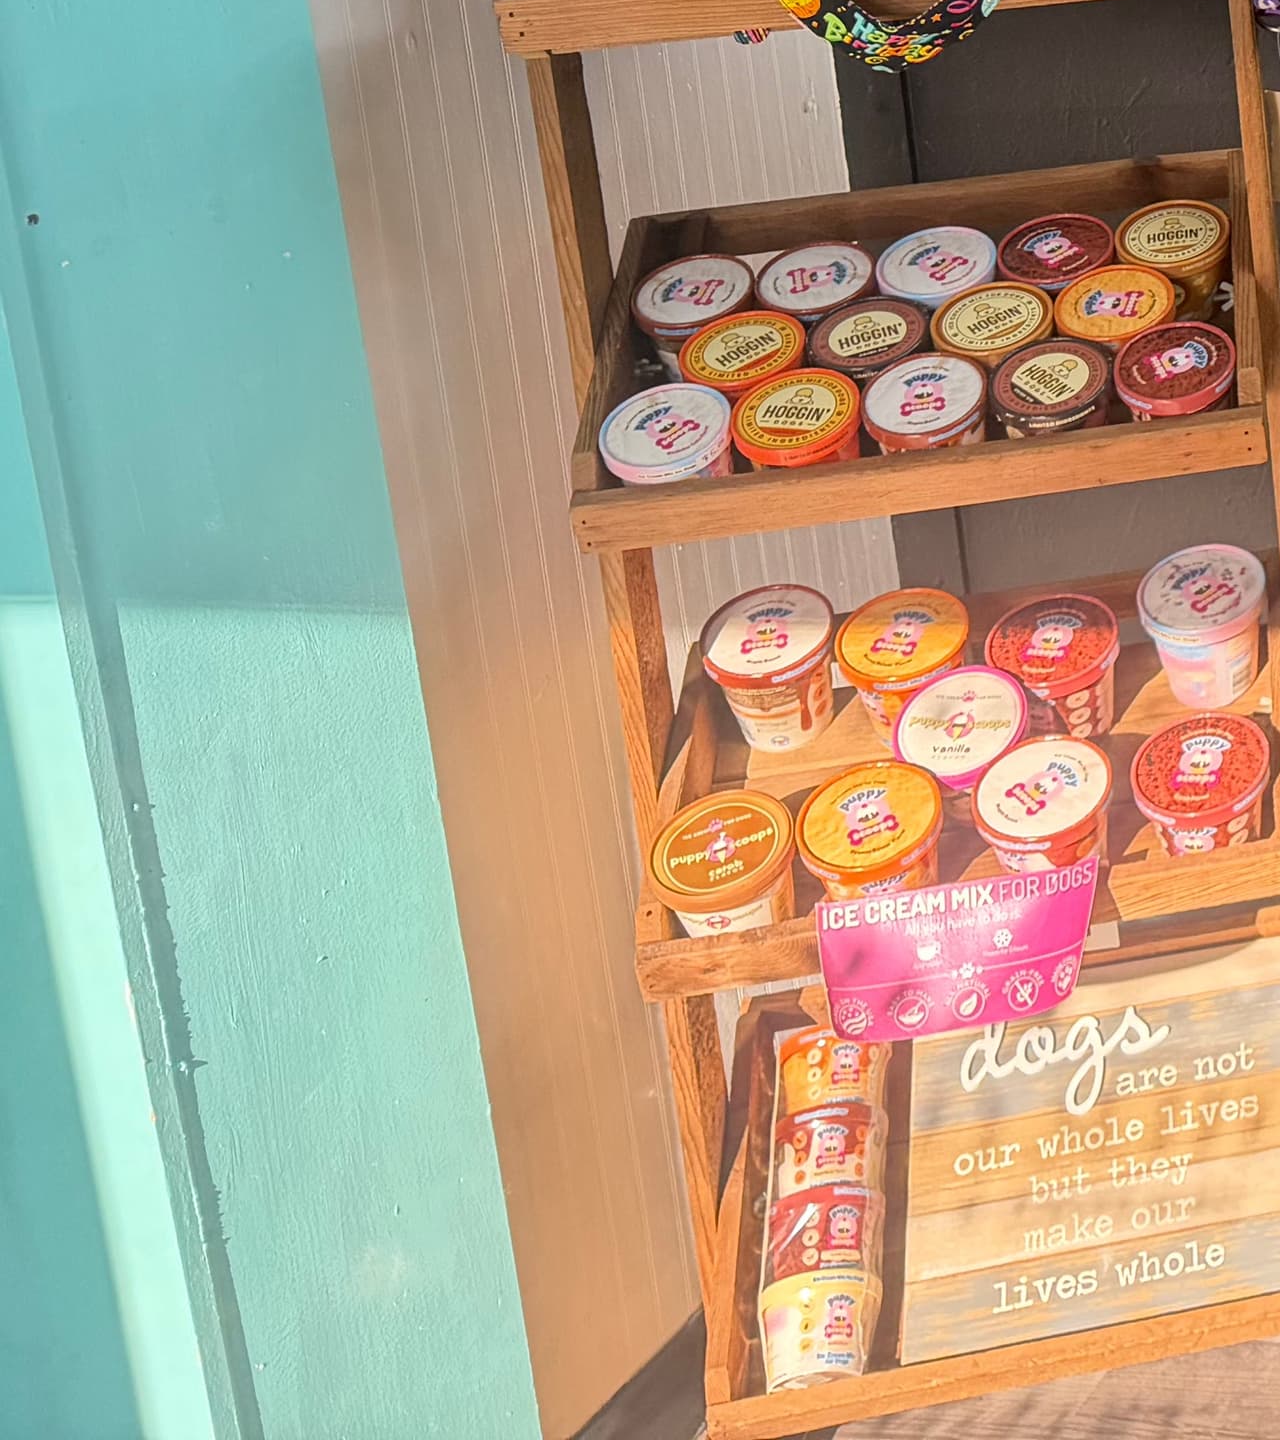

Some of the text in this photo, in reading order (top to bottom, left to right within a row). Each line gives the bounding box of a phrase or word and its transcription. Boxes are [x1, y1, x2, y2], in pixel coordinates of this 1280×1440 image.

[932, 744, 972, 753] vanilla
[821, 904, 861, 931] ICE
[864, 892, 947, 925] CREAM
[951, 883, 995, 911] MIX
[998, 877, 1041, 903] FOR
[1044, 862, 1094, 896] DOGS
[960, 1004, 1172, 1117] dogs
[1115, 1043, 1256, 1098] are not
[952, 1092, 1260, 1177] our whole lives
[1030, 1150, 1194, 1206] but they
[1022, 1194, 1197, 1255] make our
[991, 1240, 1226, 1316] lives whole
